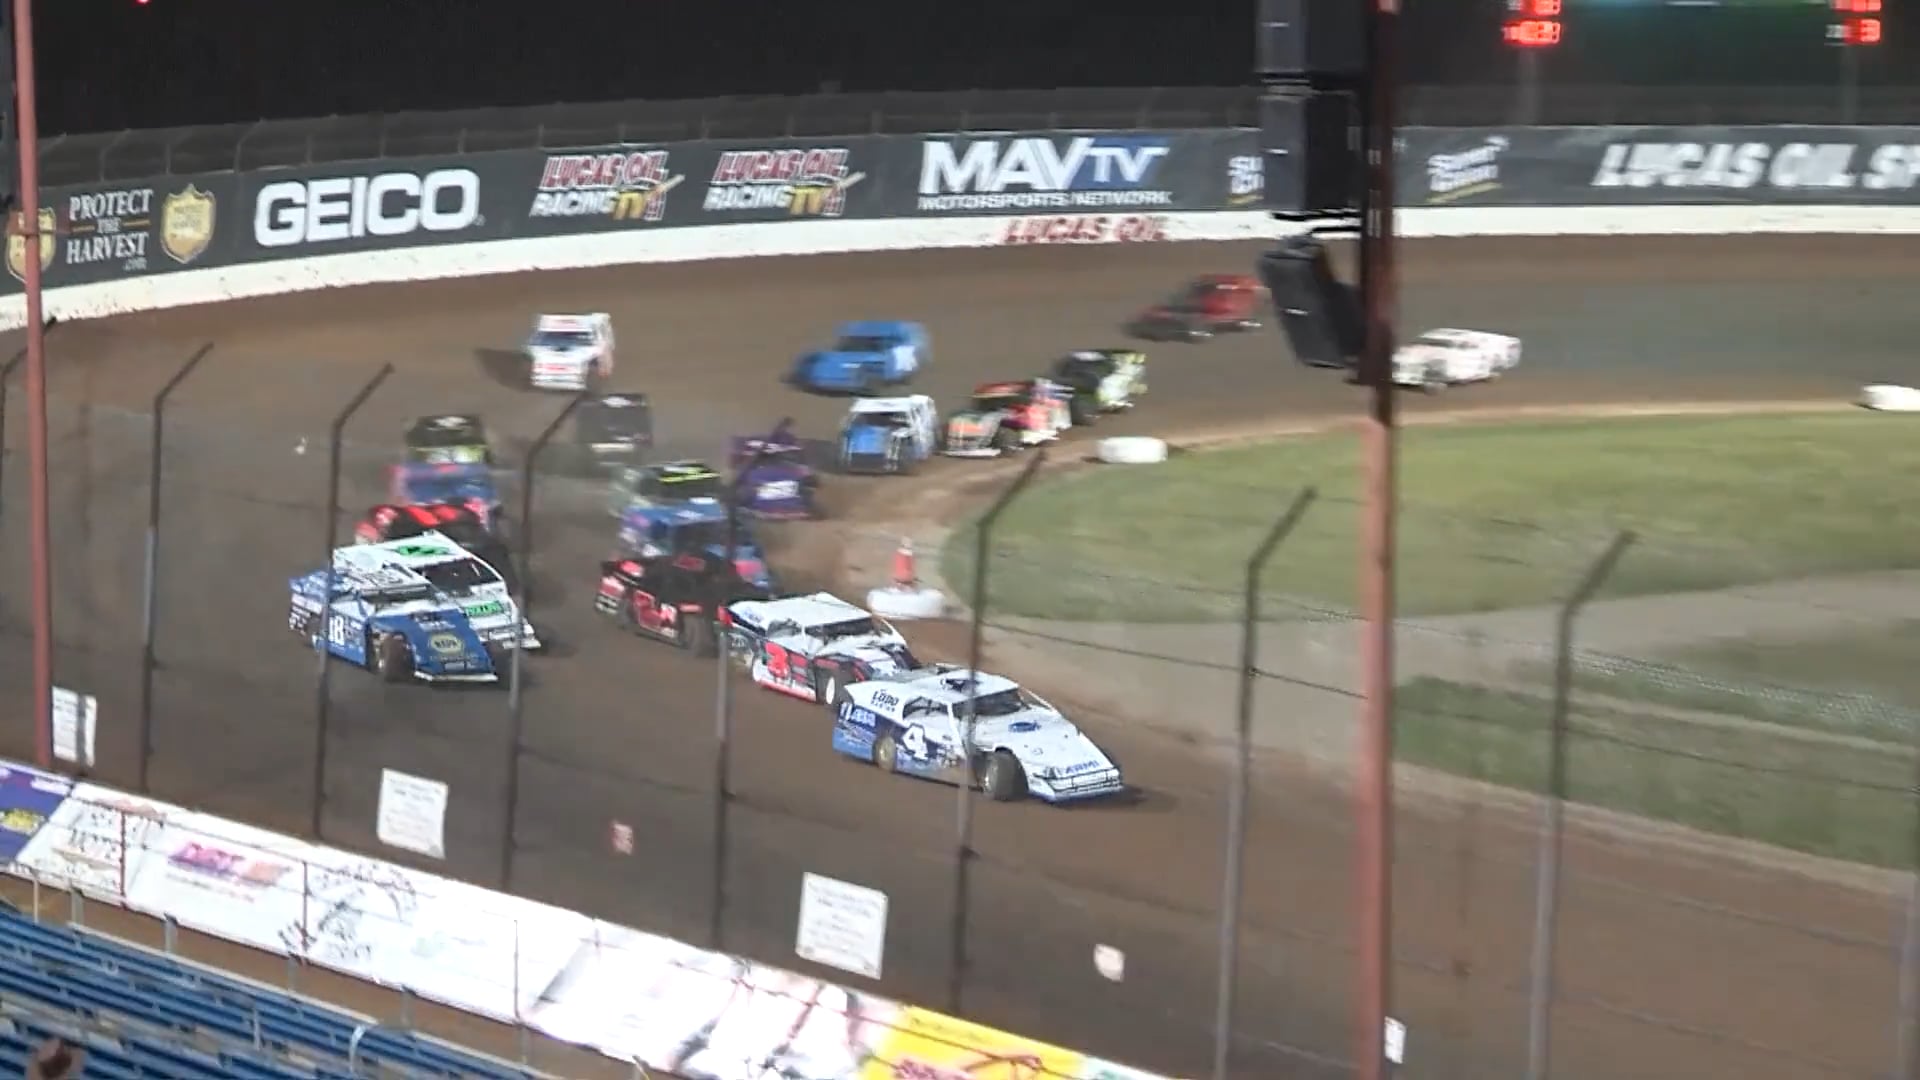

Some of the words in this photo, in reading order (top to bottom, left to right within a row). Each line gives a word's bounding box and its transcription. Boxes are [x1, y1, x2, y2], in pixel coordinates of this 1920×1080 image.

[538, 155, 627, 190] LUCAS
[622, 150, 669, 186] OIL
[709, 150, 804, 185] LUCAS
[800, 148, 850, 180] OIL
[1592, 143, 1769, 187] LUCAS
[1769, 143, 1858, 187] OIL
[69, 188, 154, 221] PROTECT
[254, 168, 481, 247] GEICO
[918, 194, 1069, 211] MOTORSPORTS
[1071, 190, 1173, 207] NETWORK
[66, 232, 149, 264] HARVEST
[1005, 218, 1104, 243] LUCAS
[902, 723, 930, 760] 4
